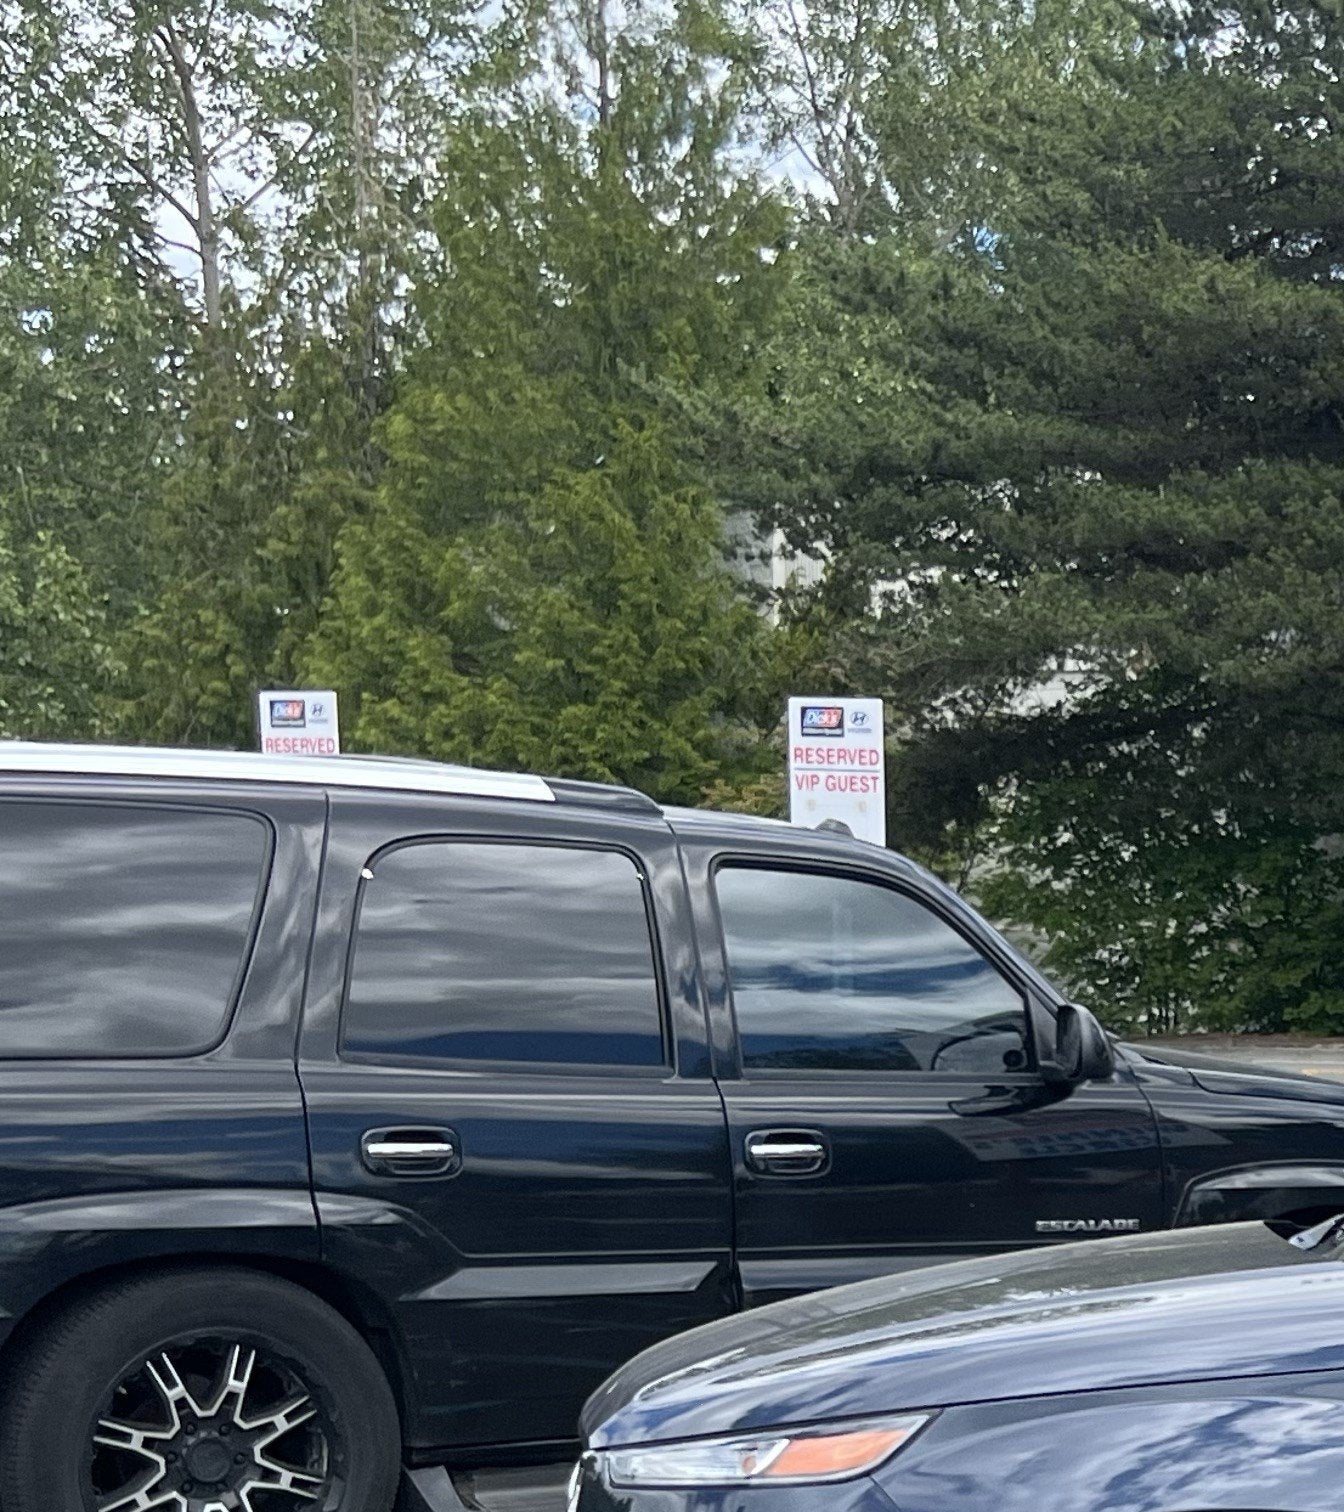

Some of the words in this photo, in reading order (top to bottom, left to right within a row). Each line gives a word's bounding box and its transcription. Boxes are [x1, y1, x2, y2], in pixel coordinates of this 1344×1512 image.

[265, 737, 335, 753] RESERVED
[794, 747, 880, 766] RESERVED
[796, 773, 820, 790] VIP
[825, 774, 879, 793] GUEST
[1035, 1219, 1140, 1232] ESCALADE
